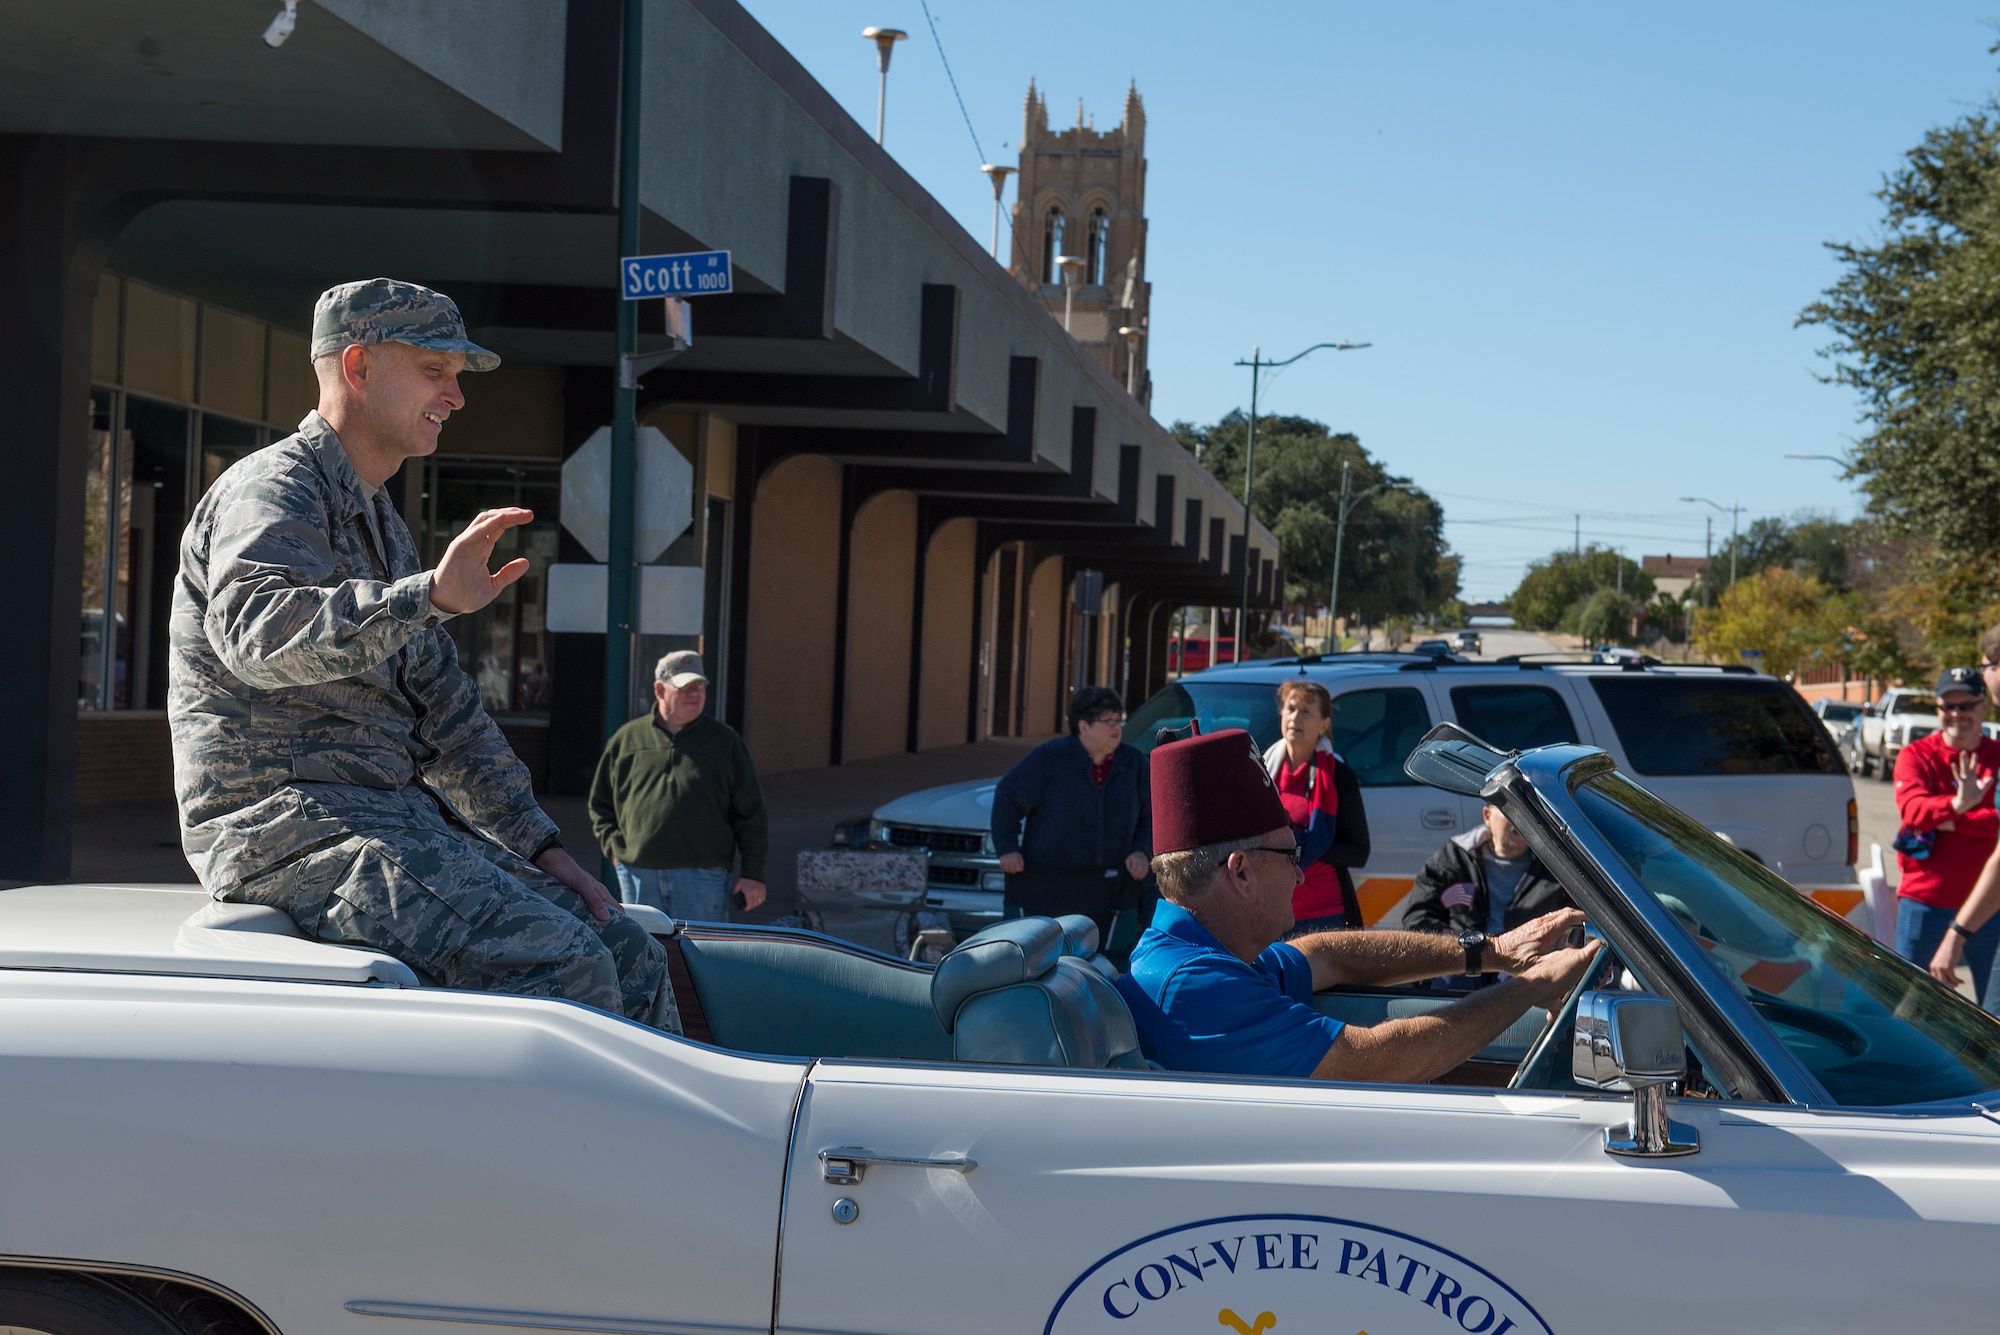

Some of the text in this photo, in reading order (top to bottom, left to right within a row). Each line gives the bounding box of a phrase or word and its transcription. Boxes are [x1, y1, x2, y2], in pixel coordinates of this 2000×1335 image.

[628, 260, 693, 293] Scott
[698, 272, 726, 289] 1000
[1950, 667, 1968, 682] T
[1103, 1233, 1319, 1319] CON-VEE
